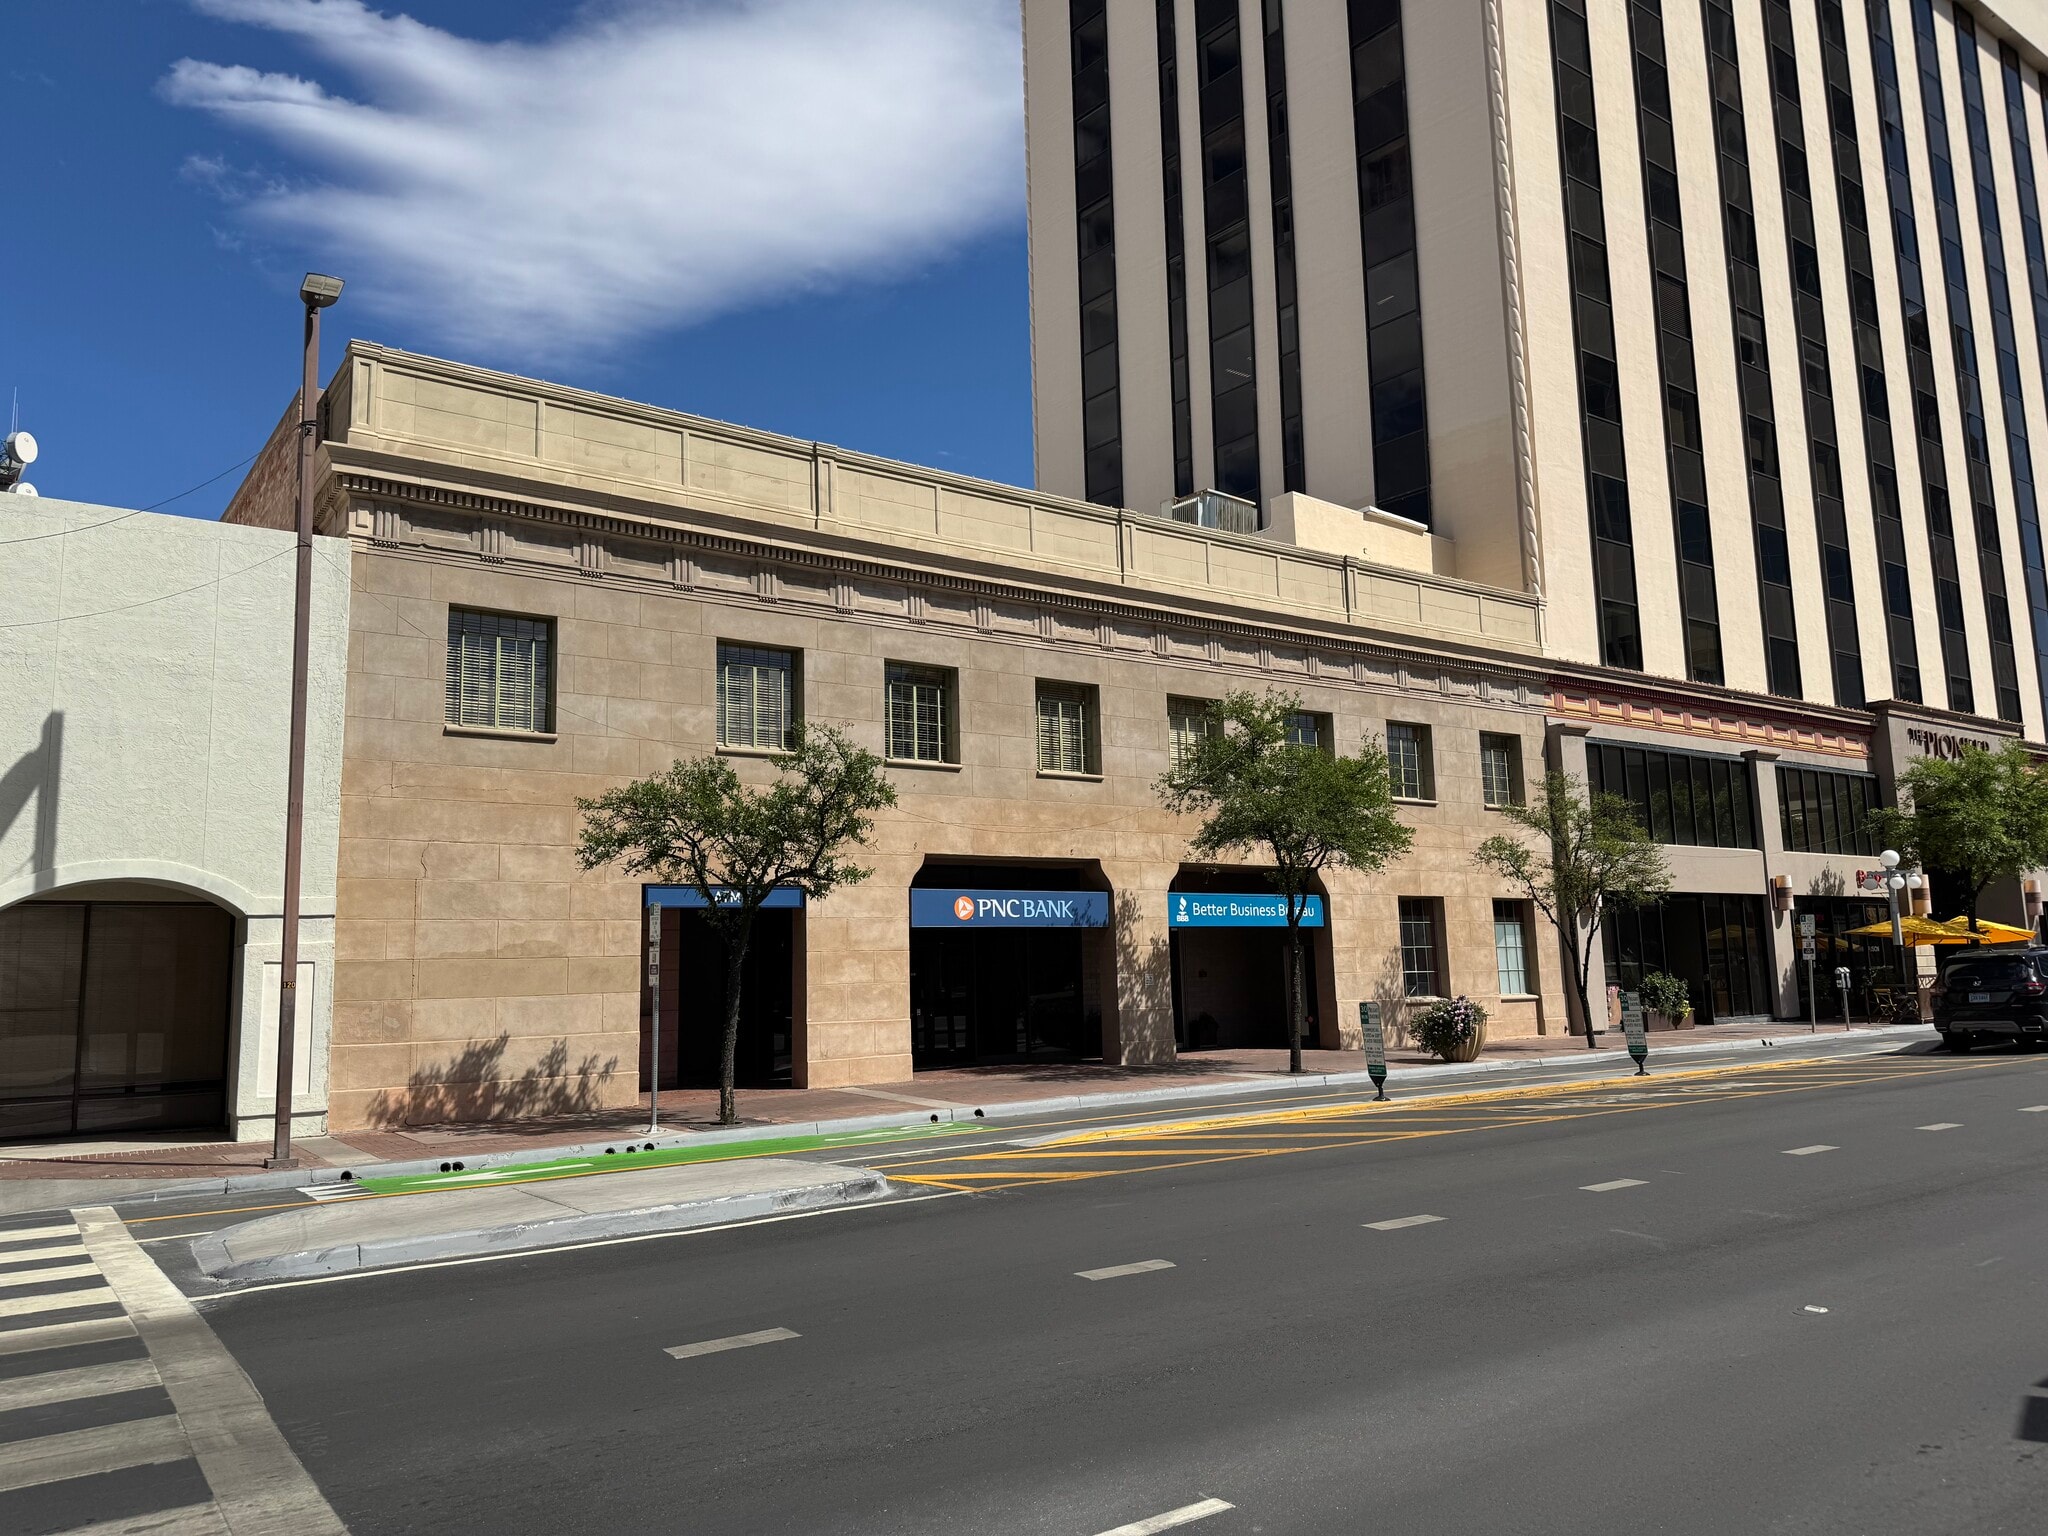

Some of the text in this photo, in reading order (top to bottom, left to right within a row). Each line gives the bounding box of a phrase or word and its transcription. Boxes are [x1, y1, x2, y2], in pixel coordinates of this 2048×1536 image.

[1907, 728, 1928, 744] THE
[976, 898, 1074, 919] PNC BANK
[1192, 902, 1228, 917] Better
[1230, 902, 1277, 917] Business
[1176, 914, 1190, 922] BBB
